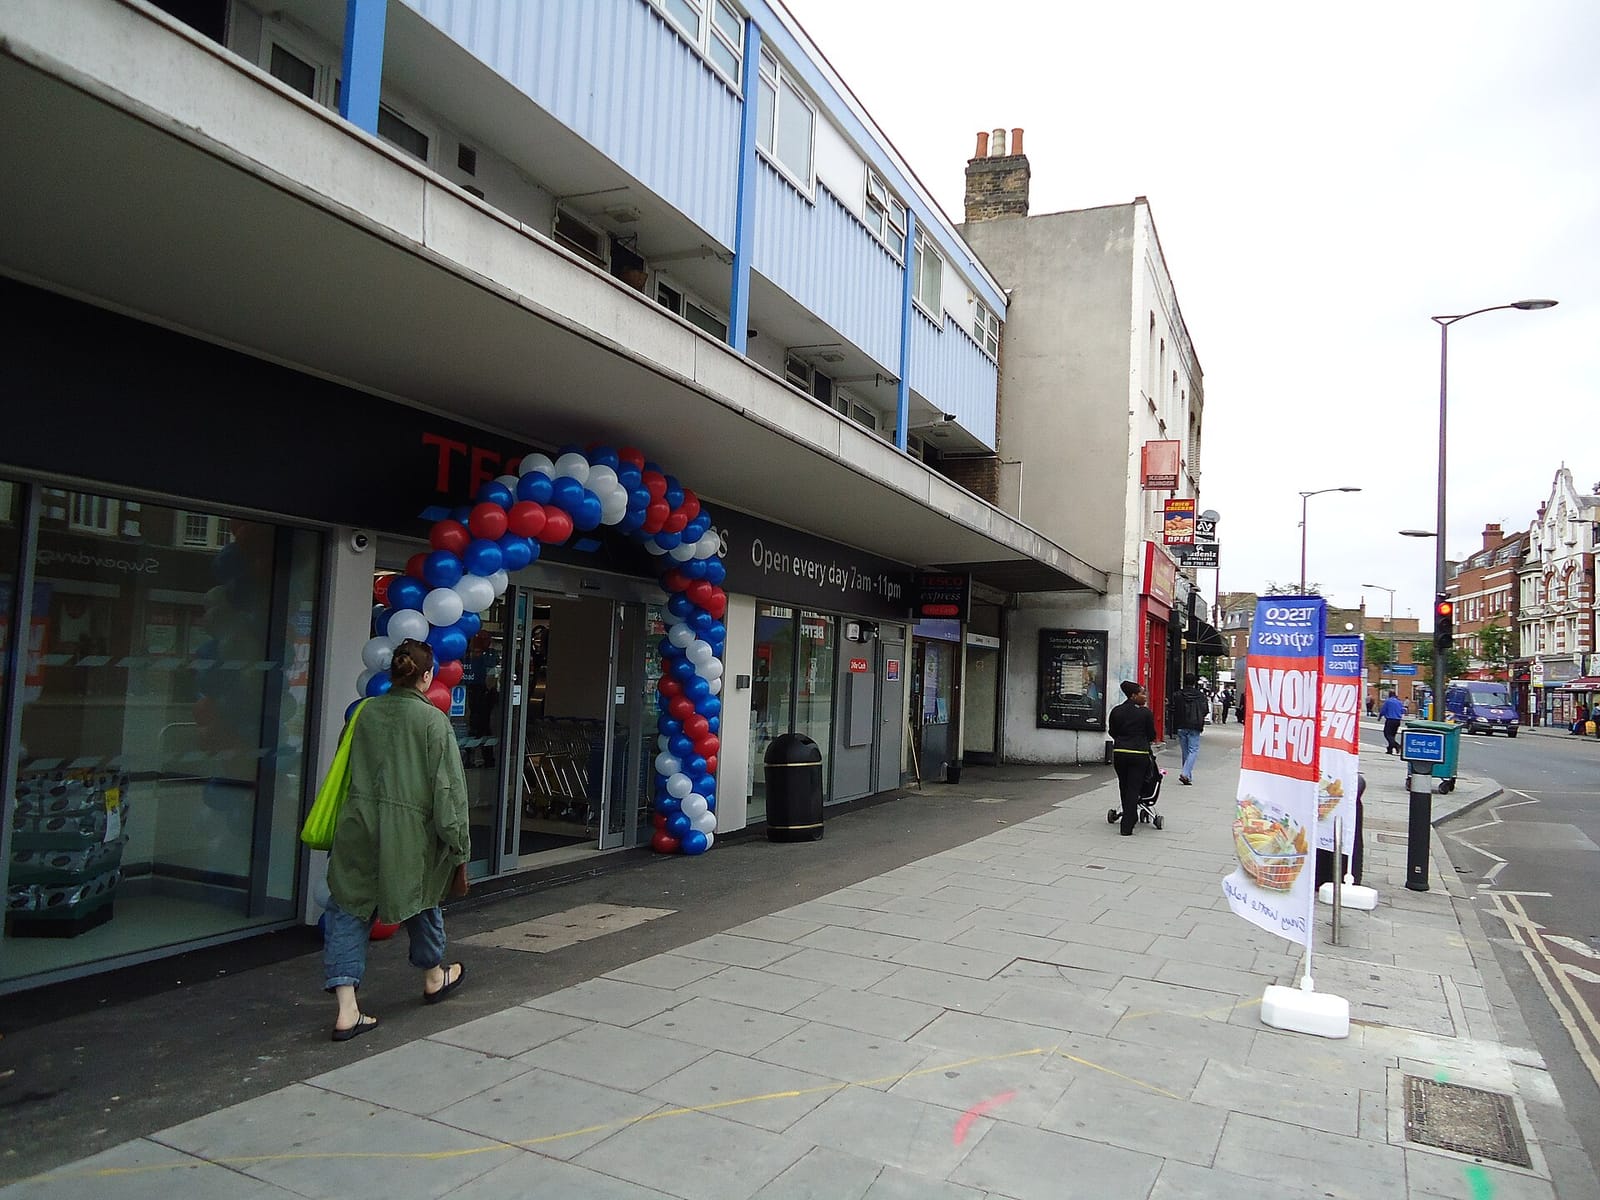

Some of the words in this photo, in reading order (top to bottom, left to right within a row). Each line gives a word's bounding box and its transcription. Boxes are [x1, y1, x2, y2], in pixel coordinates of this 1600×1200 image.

[752, 538, 790, 575] Open
[793, 556, 827, 587] every
[828, 561, 849, 592] day
[850, 565, 872, 592] 7am
[920, 591, 961, 602] express
[1422, 747, 1439, 755] lane
